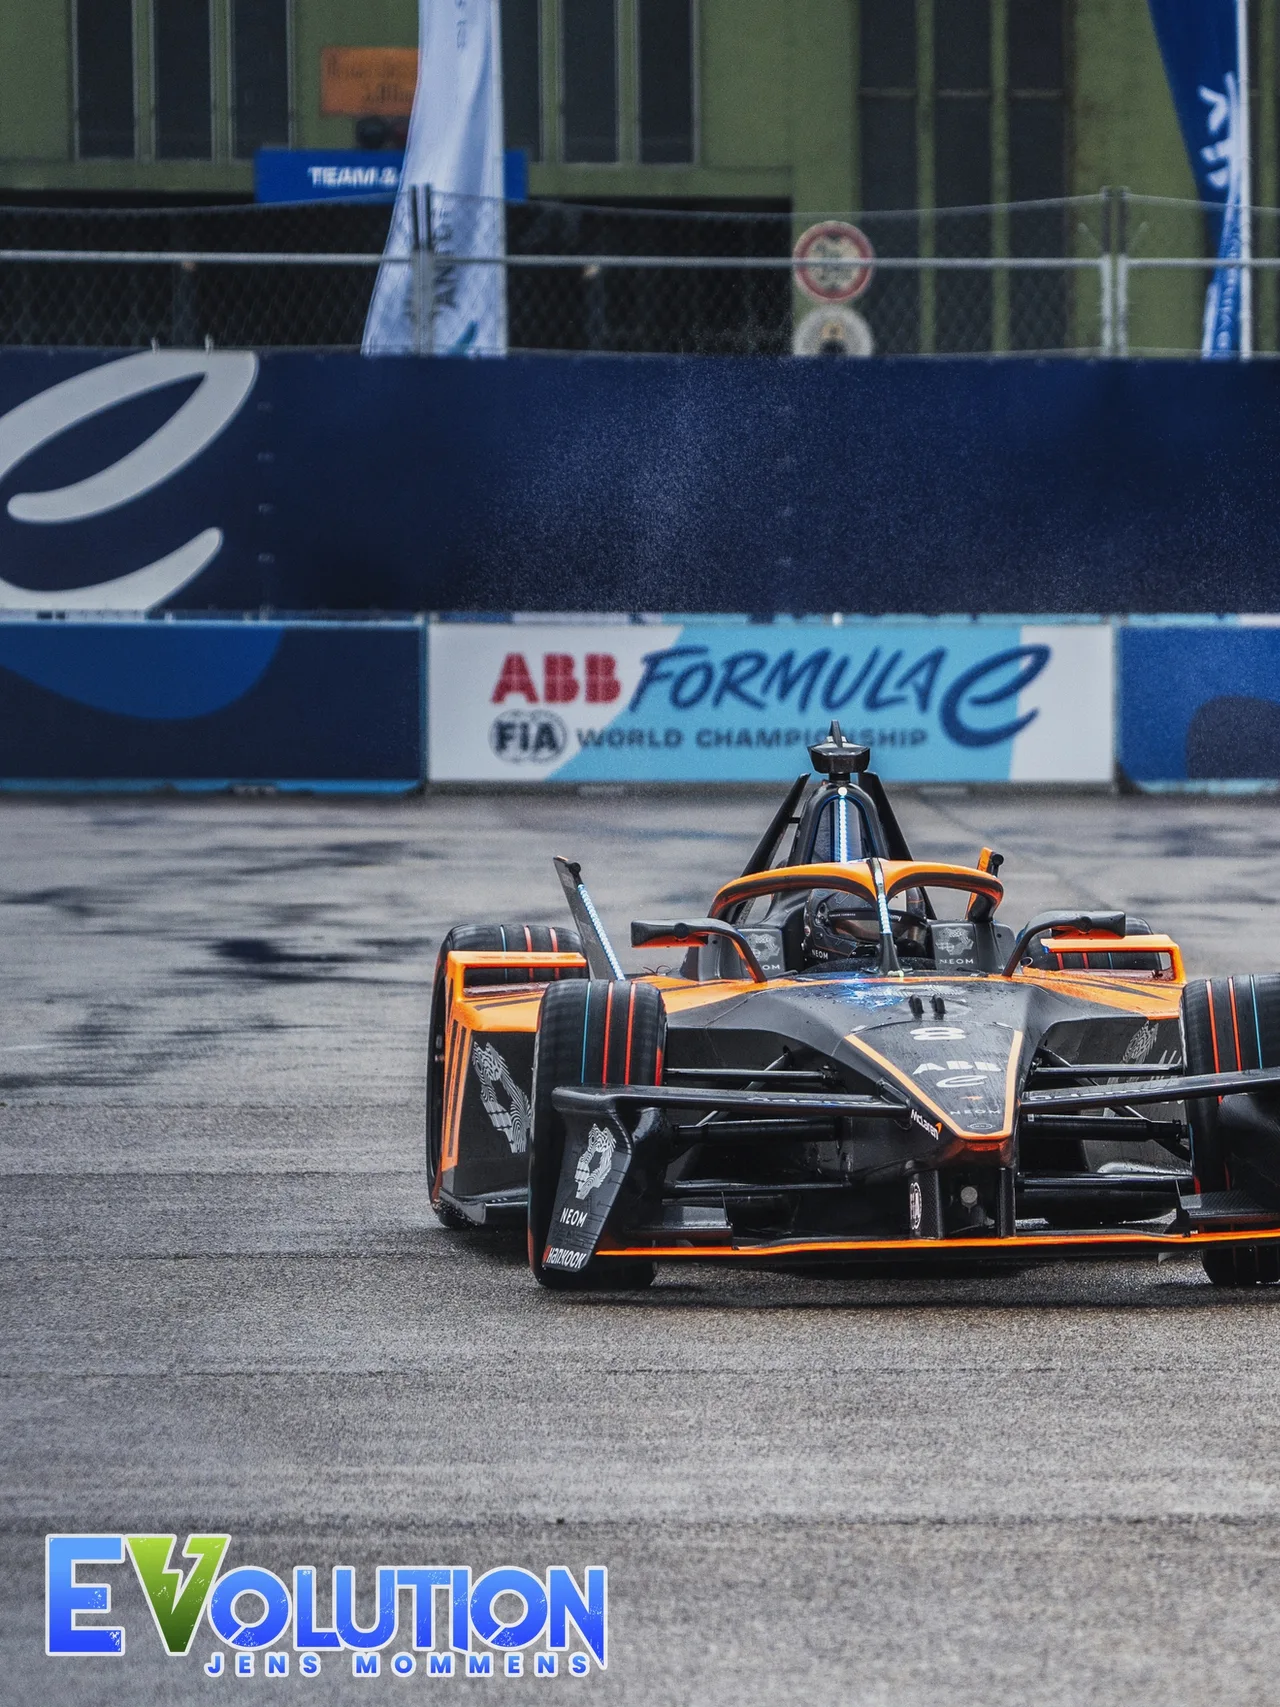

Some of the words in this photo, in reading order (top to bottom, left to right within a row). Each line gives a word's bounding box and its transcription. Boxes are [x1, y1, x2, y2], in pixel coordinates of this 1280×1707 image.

[309, 166, 375, 185] TEAM
[490, 652, 622, 705] ABB
[627, 645, 947, 715] FORMULA
[576, 728, 684, 748] WORLD
[811, 948, 829, 960] NEOM
[909, 1026, 967, 1041] 8
[559, 1207, 588, 1228] NEOM
